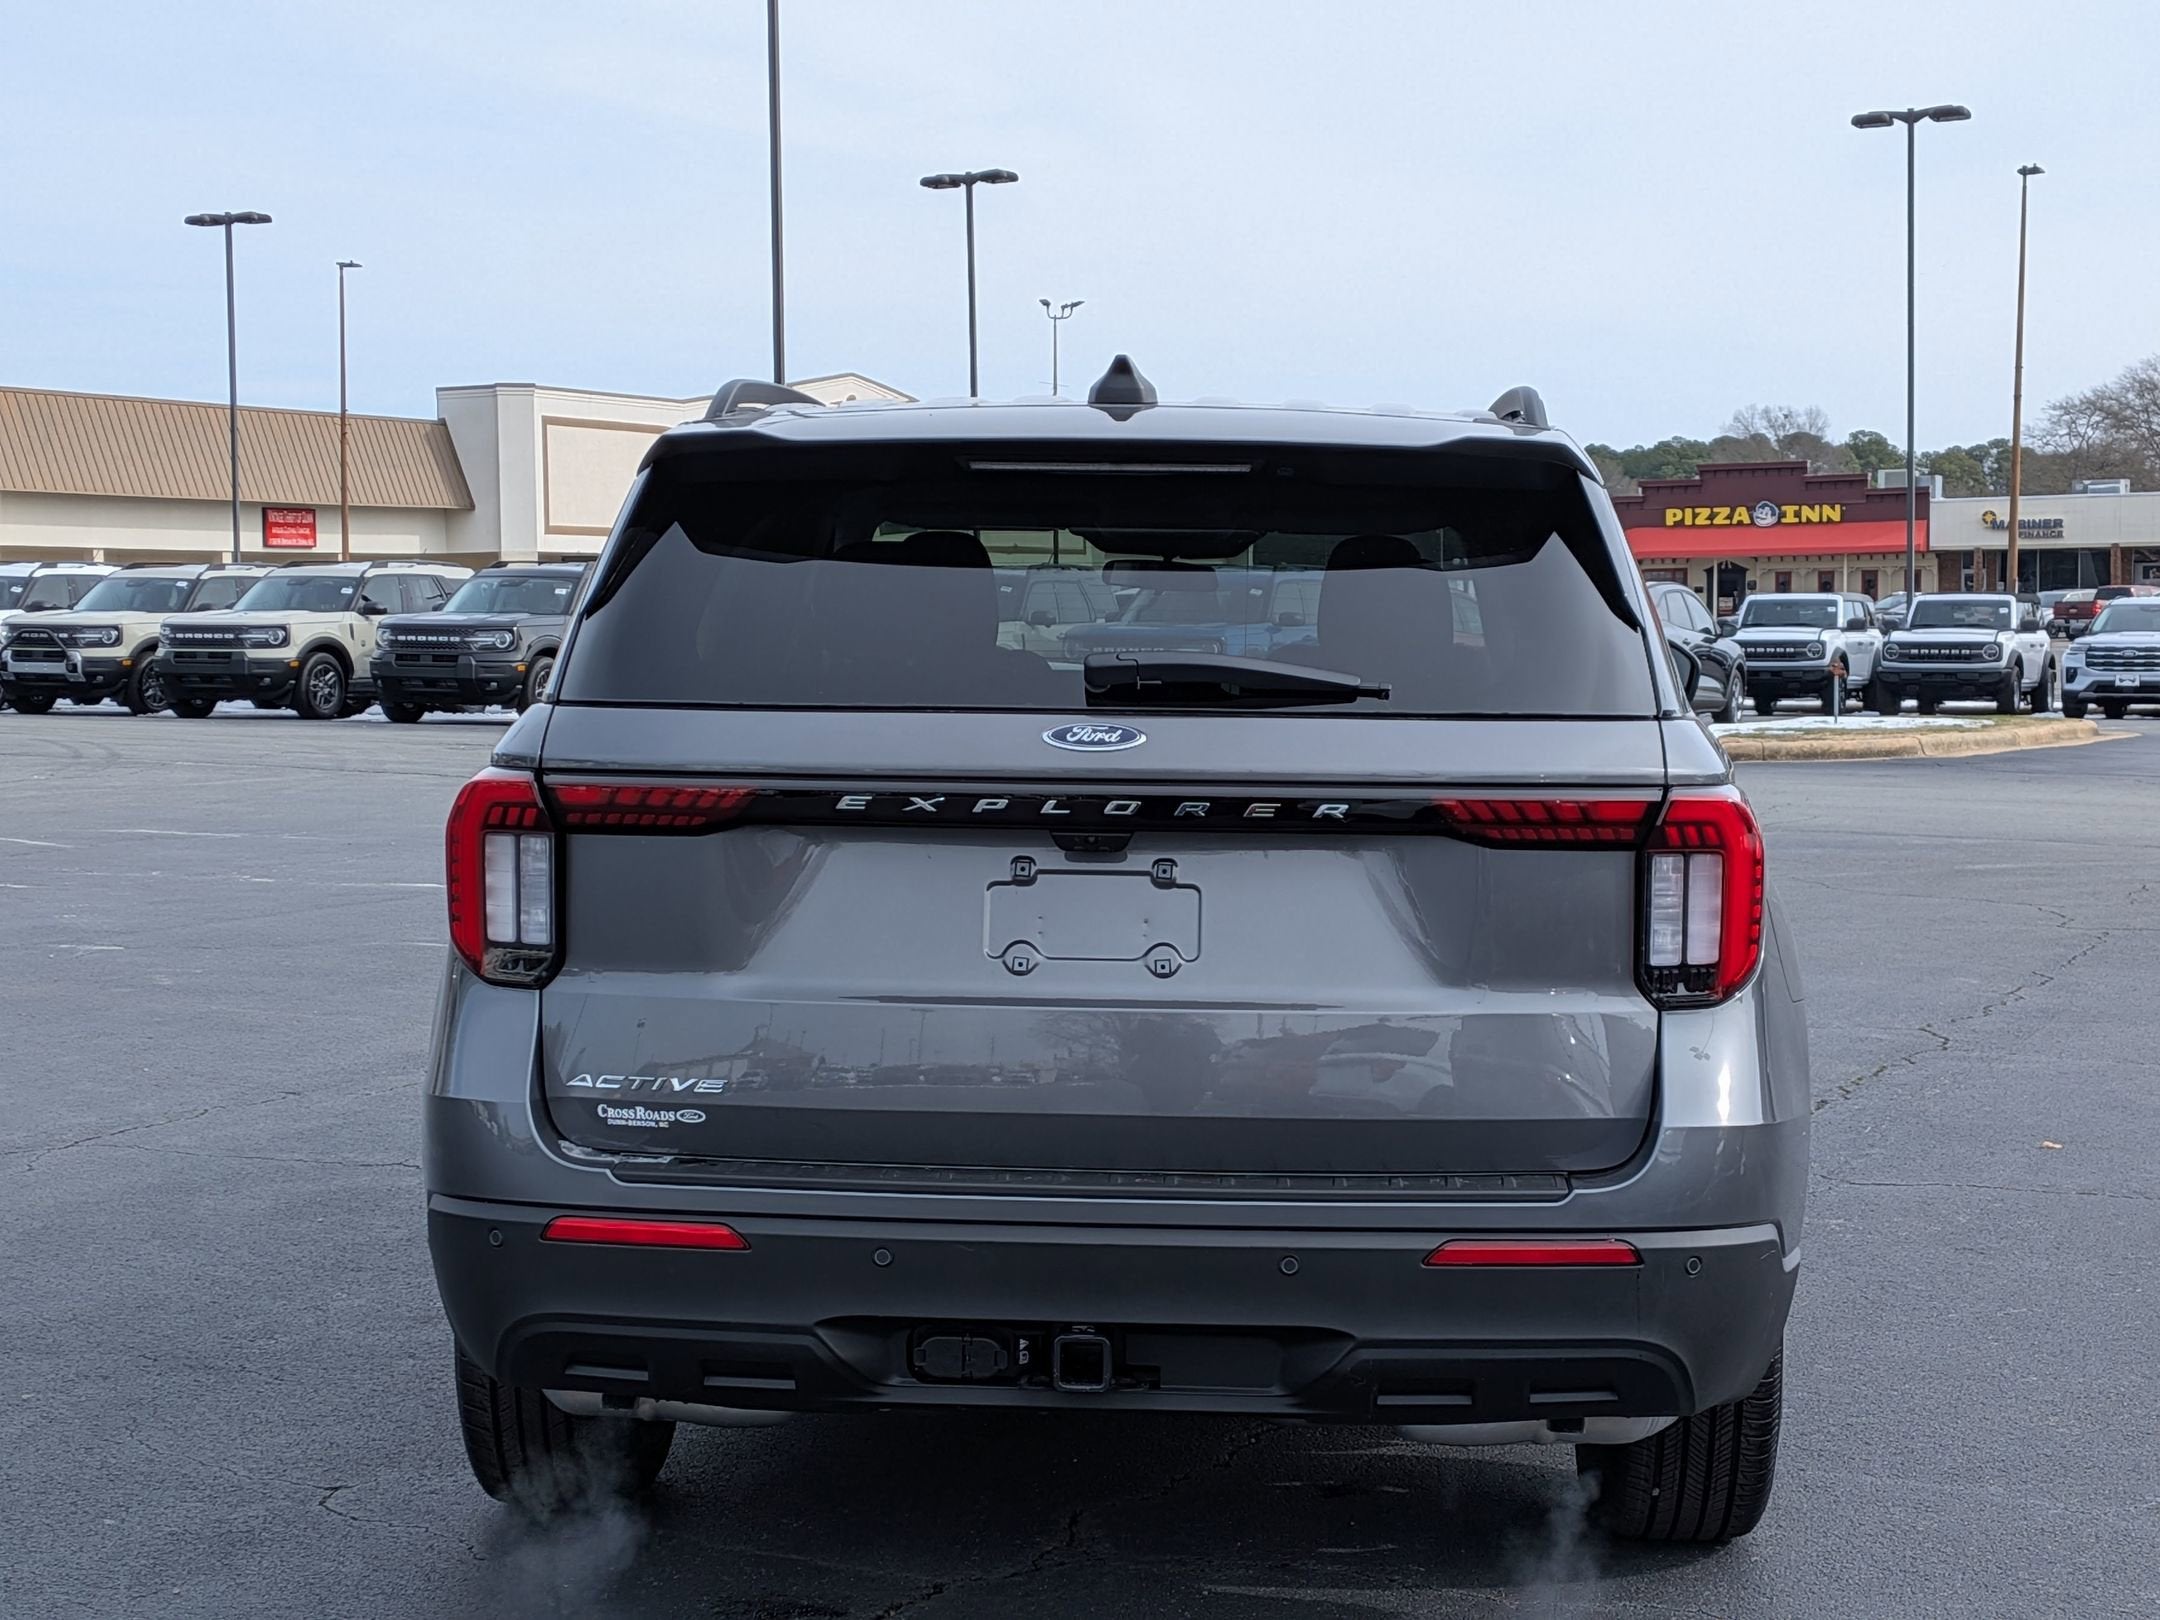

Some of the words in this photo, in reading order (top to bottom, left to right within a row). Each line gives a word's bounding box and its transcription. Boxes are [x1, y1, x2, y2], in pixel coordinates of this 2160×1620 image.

[1665, 506, 1751, 527] PIZZA
[1780, 504, 1842, 523] INN
[1991, 518, 2064, 530] MRINER
[1066, 725, 1123, 742] Ford
[835, 795, 1350, 820] EXPLORER
[566, 1073, 729, 1093] ACTIVE
